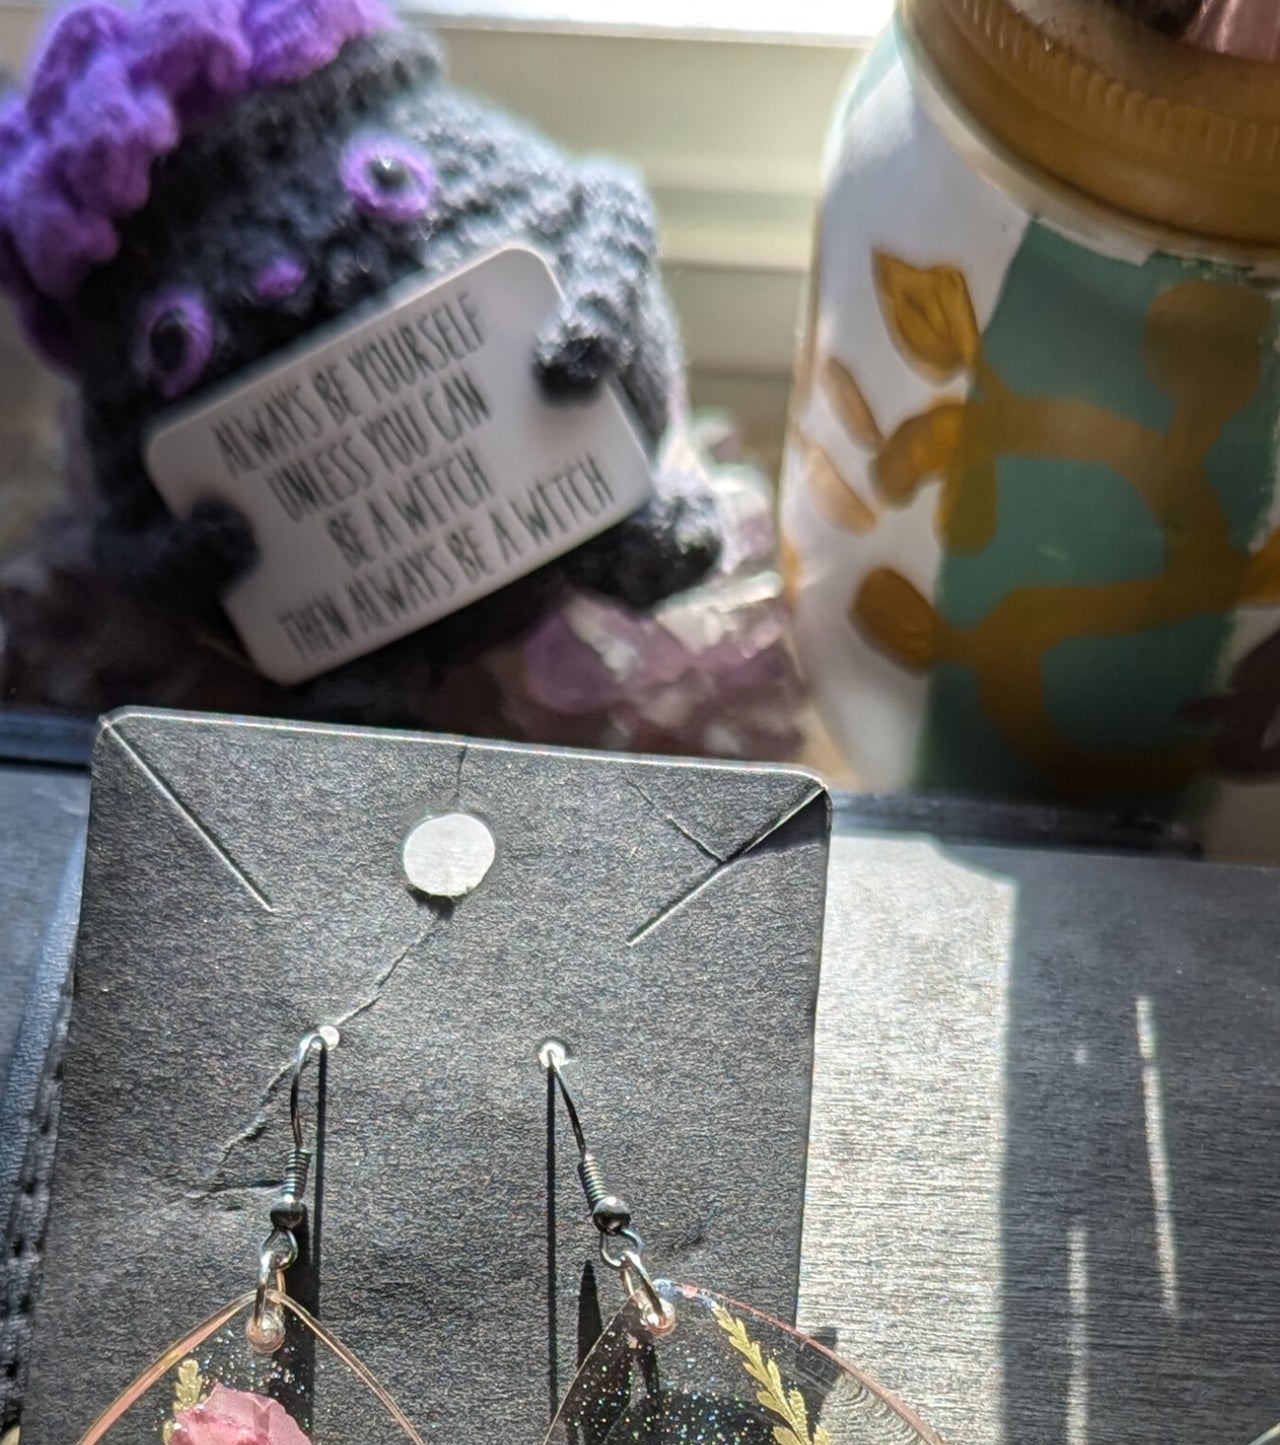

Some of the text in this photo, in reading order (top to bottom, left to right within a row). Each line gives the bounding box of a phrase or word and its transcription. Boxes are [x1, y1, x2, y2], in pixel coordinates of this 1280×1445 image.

[208, 292, 486, 478] ALWAYS BE YOURSELF
[266, 369, 493, 524] UNLESS YOU CAN
[276, 453, 615, 662] THEN ALWAYS BE A WITCH
[326, 446, 496, 569] BE A WITCH
